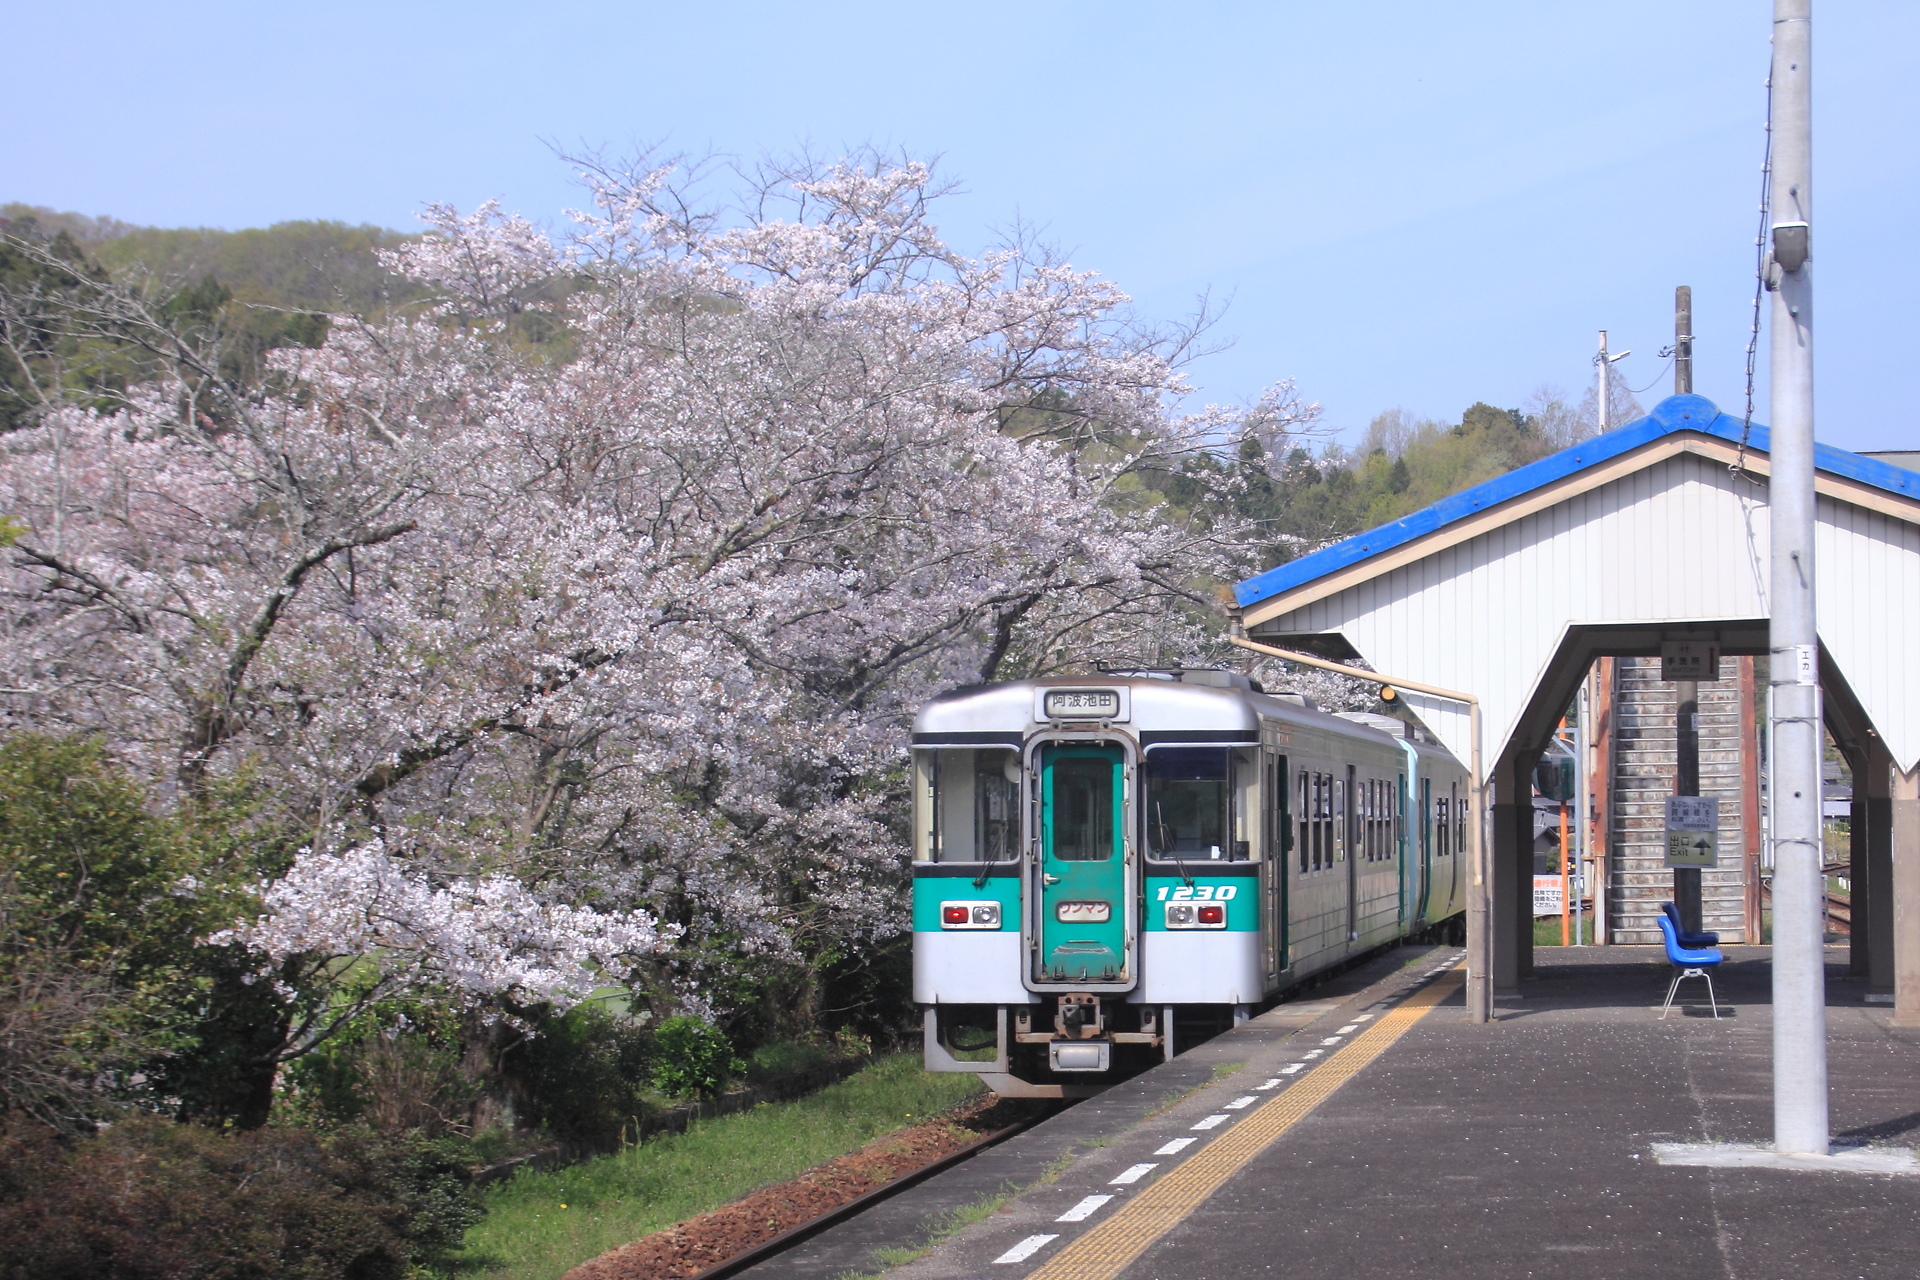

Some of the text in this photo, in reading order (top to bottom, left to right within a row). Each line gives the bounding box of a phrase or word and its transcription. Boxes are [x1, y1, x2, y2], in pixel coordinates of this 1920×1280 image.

[1052, 693, 1112, 708] 阿波池田
[1670, 836, 1690, 847] 出口
[1670, 847, 1689, 857] Exit
[1156, 885, 1238, 901] 1230
